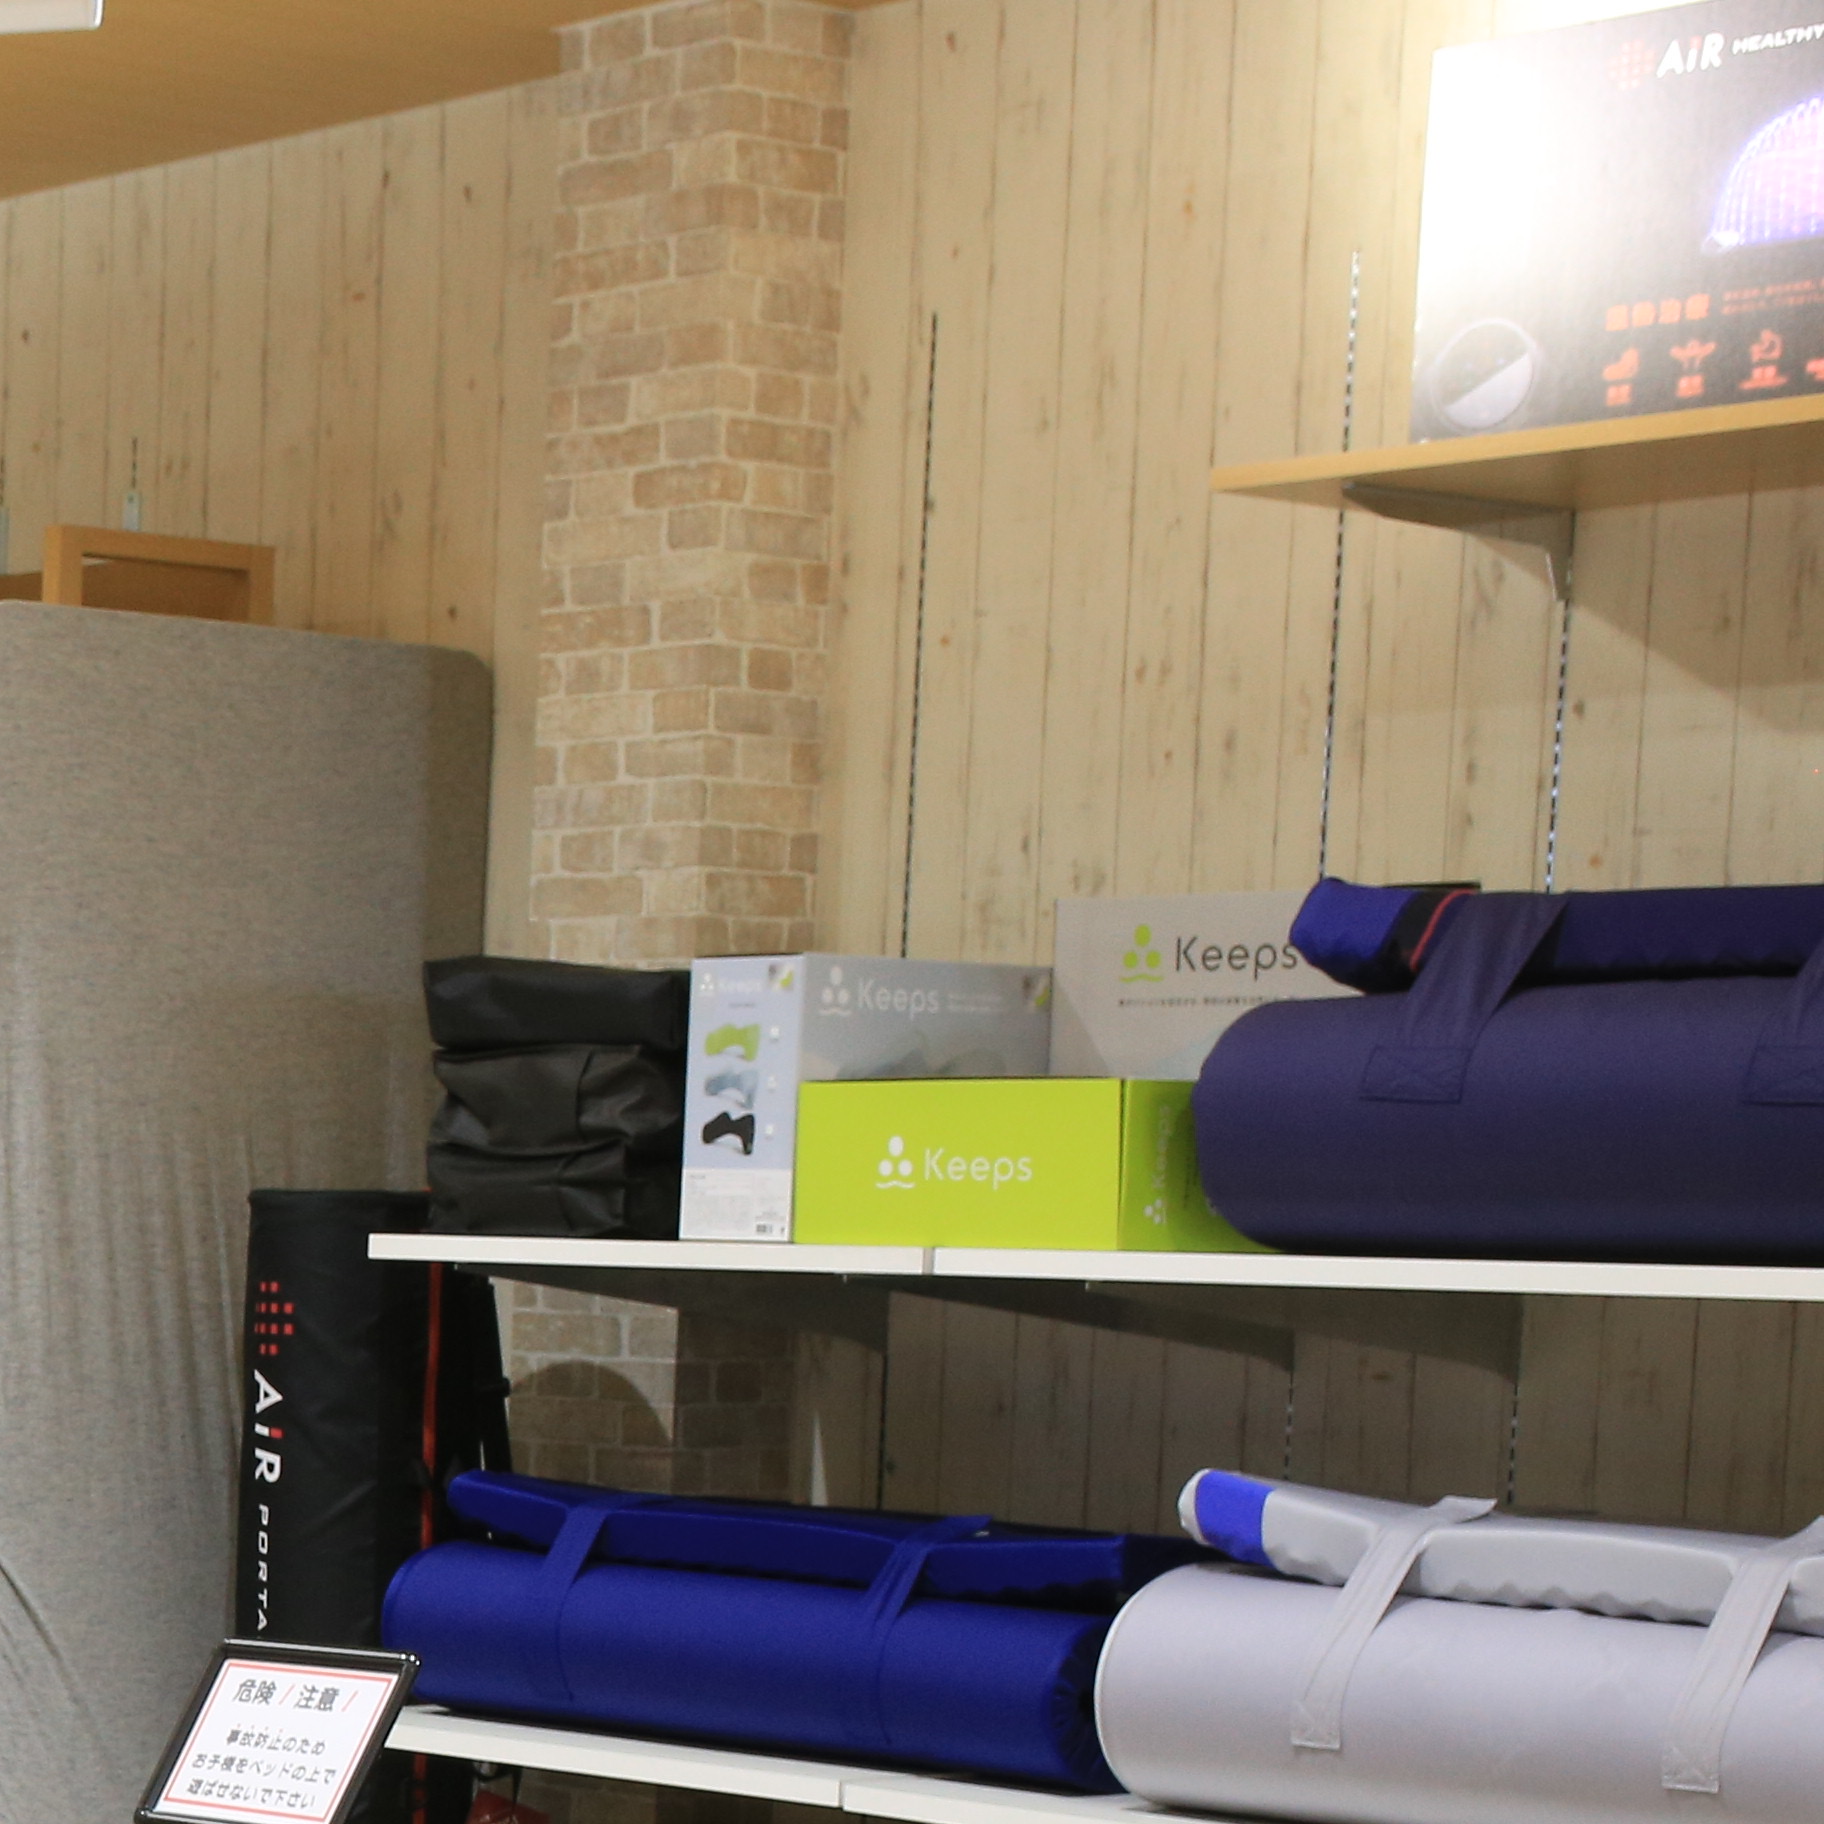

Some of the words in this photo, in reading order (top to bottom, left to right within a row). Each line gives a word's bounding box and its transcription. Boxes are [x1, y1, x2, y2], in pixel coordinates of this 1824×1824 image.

[1732, 22, 1824, 56] HEALTHY
[1175, 935, 1299, 982] Keeps
[857, 977, 940, 1021] Keeps
[923, 1146, 1034, 1191] Keeps
[254, 1368, 285, 1484] AiR
[232, 1678, 277, 1706] 危険
[293, 1684, 340, 1712] 注意
[226, 1728, 327, 1757] 事故防止のため
[191, 1753, 338, 1785] お子様をベッドの上で
[187, 1778, 317, 1809] 遊ばせないで下さい
